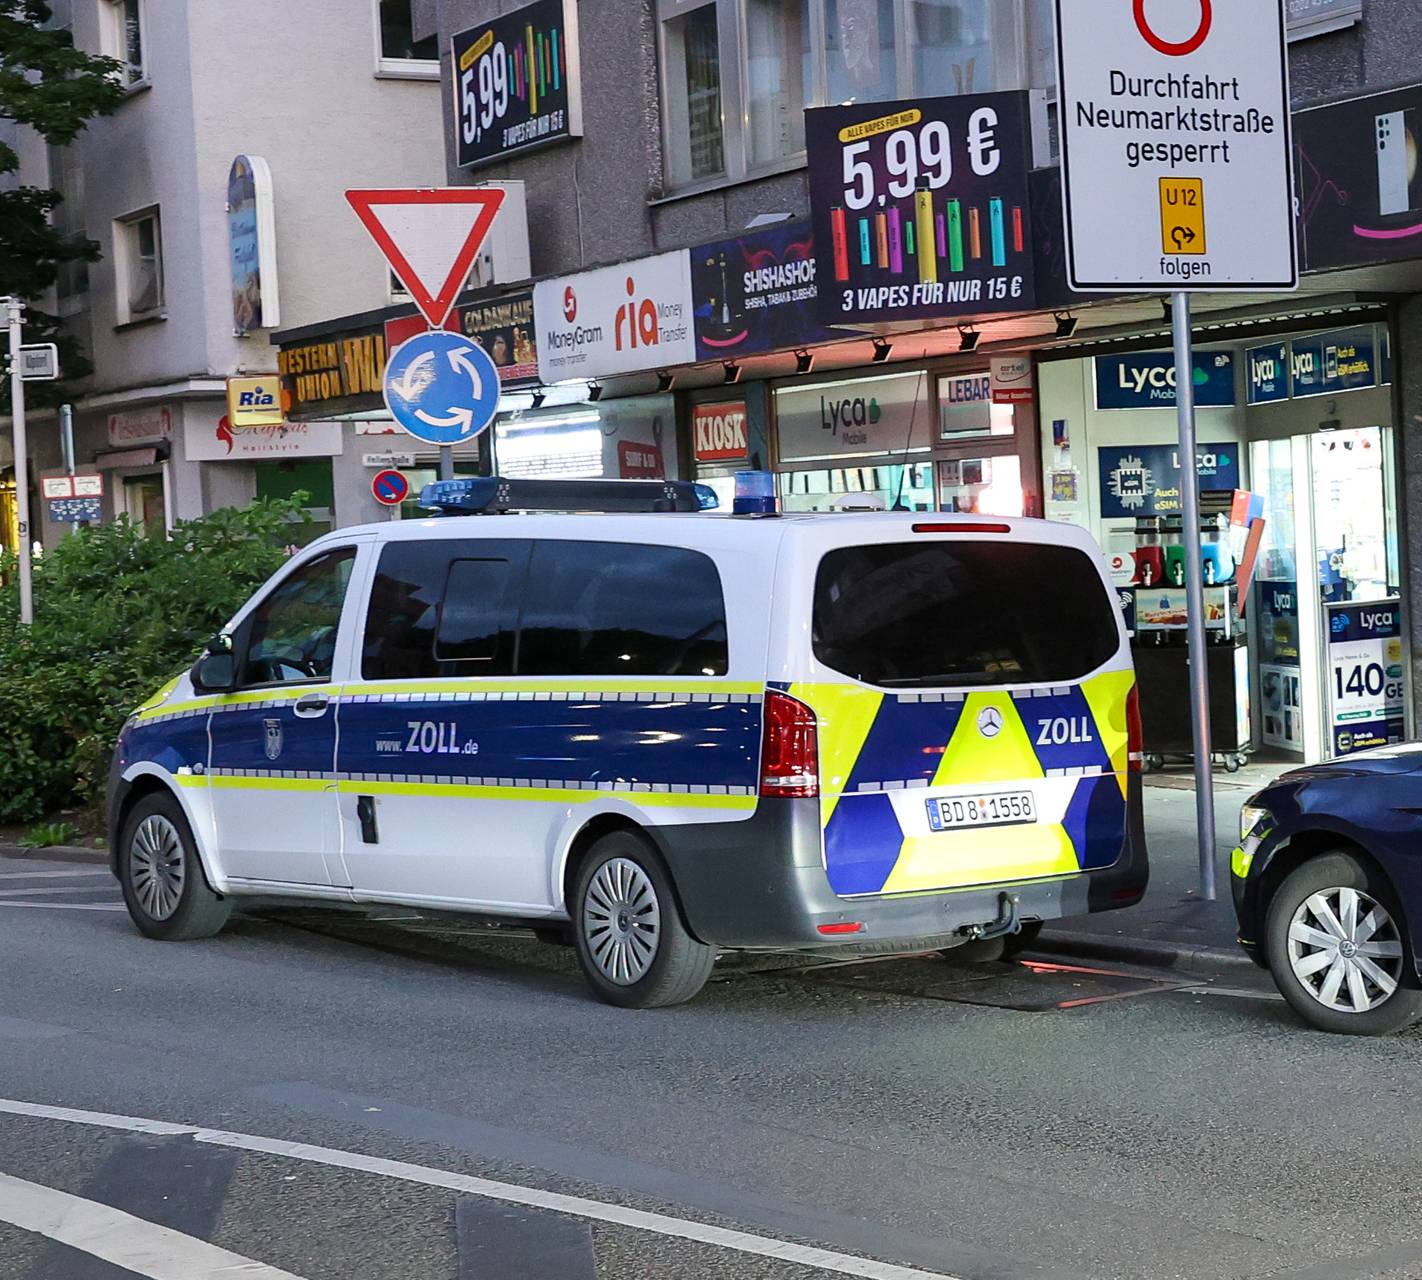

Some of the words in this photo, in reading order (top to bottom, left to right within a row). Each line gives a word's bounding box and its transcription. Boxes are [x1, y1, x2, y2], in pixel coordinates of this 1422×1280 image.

[461, 41, 508, 145] 5,99
[1109, 69, 1240, 101] Durchfahrt
[847, 126, 864, 138] ALLE
[864, 119, 886, 133] VAPES
[900, 112, 914, 124] NUR
[1076, 101, 1275, 134] Neumarktstraße
[842, 120, 953, 210] 5,99
[967, 106, 1001, 176] €
[1126, 140, 1230, 169] gesperrt
[1166, 188, 1178, 206] U
[1181, 188, 1197, 207] 12
[1160, 257, 1212, 280] folgen
[841, 289, 853, 312] 3
[858, 283, 908, 310] VAPES
[911, 278, 943, 305] FÜR
[946, 278, 982, 302] NUR
[986, 277, 1007, 300] 15
[1010, 275, 1024, 299] €
[615, 277, 658, 351] ria
[658, 303, 683, 319] Money
[547, 326, 602, 351] MoneyGram
[658, 322, 688, 345] Transfer
[277, 342, 338, 375] WESTERN
[343, 335, 386, 394] WU
[1252, 358, 1275, 387] Lyca
[1291, 351, 1313, 379] Lyca
[239, 386, 273, 406] Ria
[297, 370, 341, 402] UNION
[949, 380, 990, 403] LEBAR
[821, 396, 866, 436] Lyca
[696, 412, 746, 451] KIOSK
[842, 432, 867, 445] Mobile
[1173, 452, 1216, 469] Lca
[1154, 488, 1179, 498] Auch
[1154, 501, 1178, 511] eSIM
[1274, 590, 1291, 611] Lyca
[1360, 612, 1393, 630] Lyca
[1335, 662, 1385, 700] 140
[1036, 716, 1093, 745] ZOLL
[941, 802, 964, 822] BD
[967, 801, 978, 821] 8
[989, 796, 1031, 819] 1558
